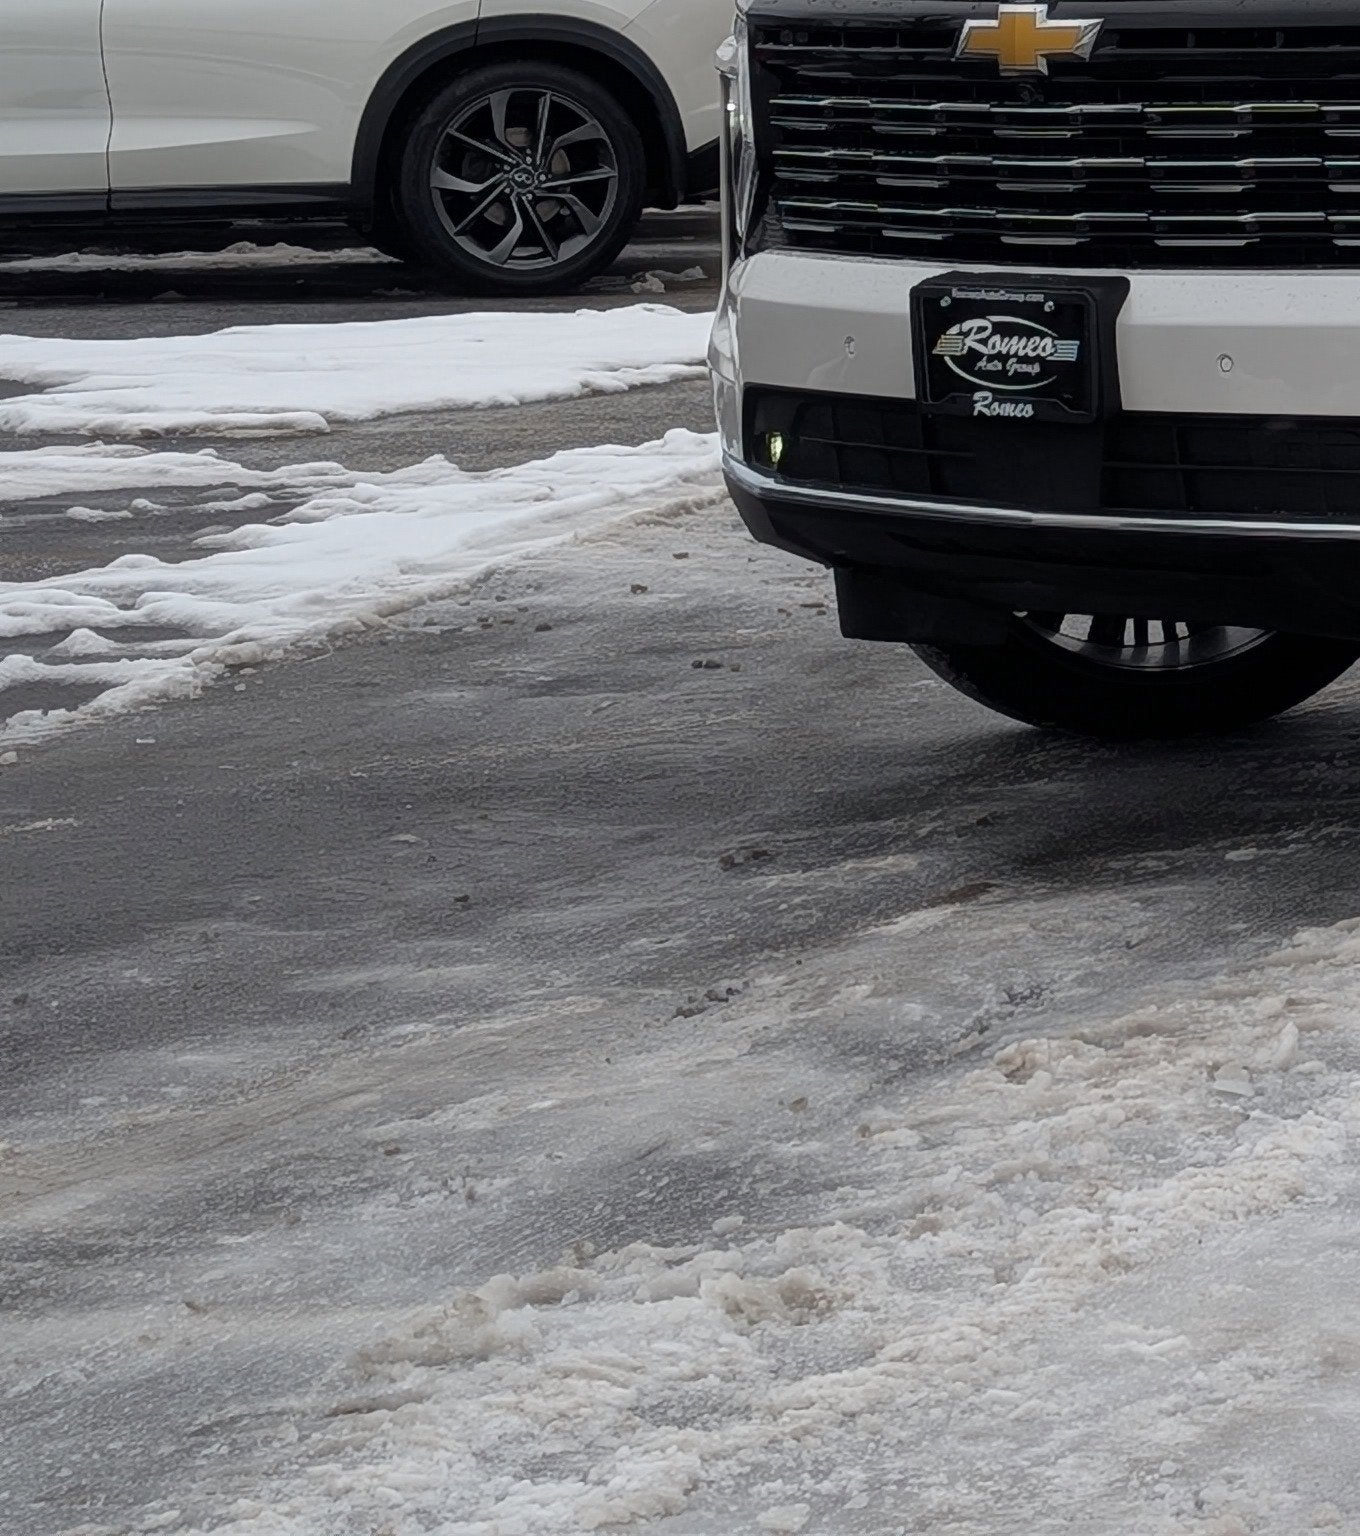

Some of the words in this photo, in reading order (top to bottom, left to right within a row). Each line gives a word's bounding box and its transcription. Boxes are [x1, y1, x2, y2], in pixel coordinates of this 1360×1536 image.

[961, 318, 1056, 357] Romeo
[974, 355, 1003, 371] Auto
[1005, 357, 1041, 376] Group
[972, 390, 1034, 418] Romeo
